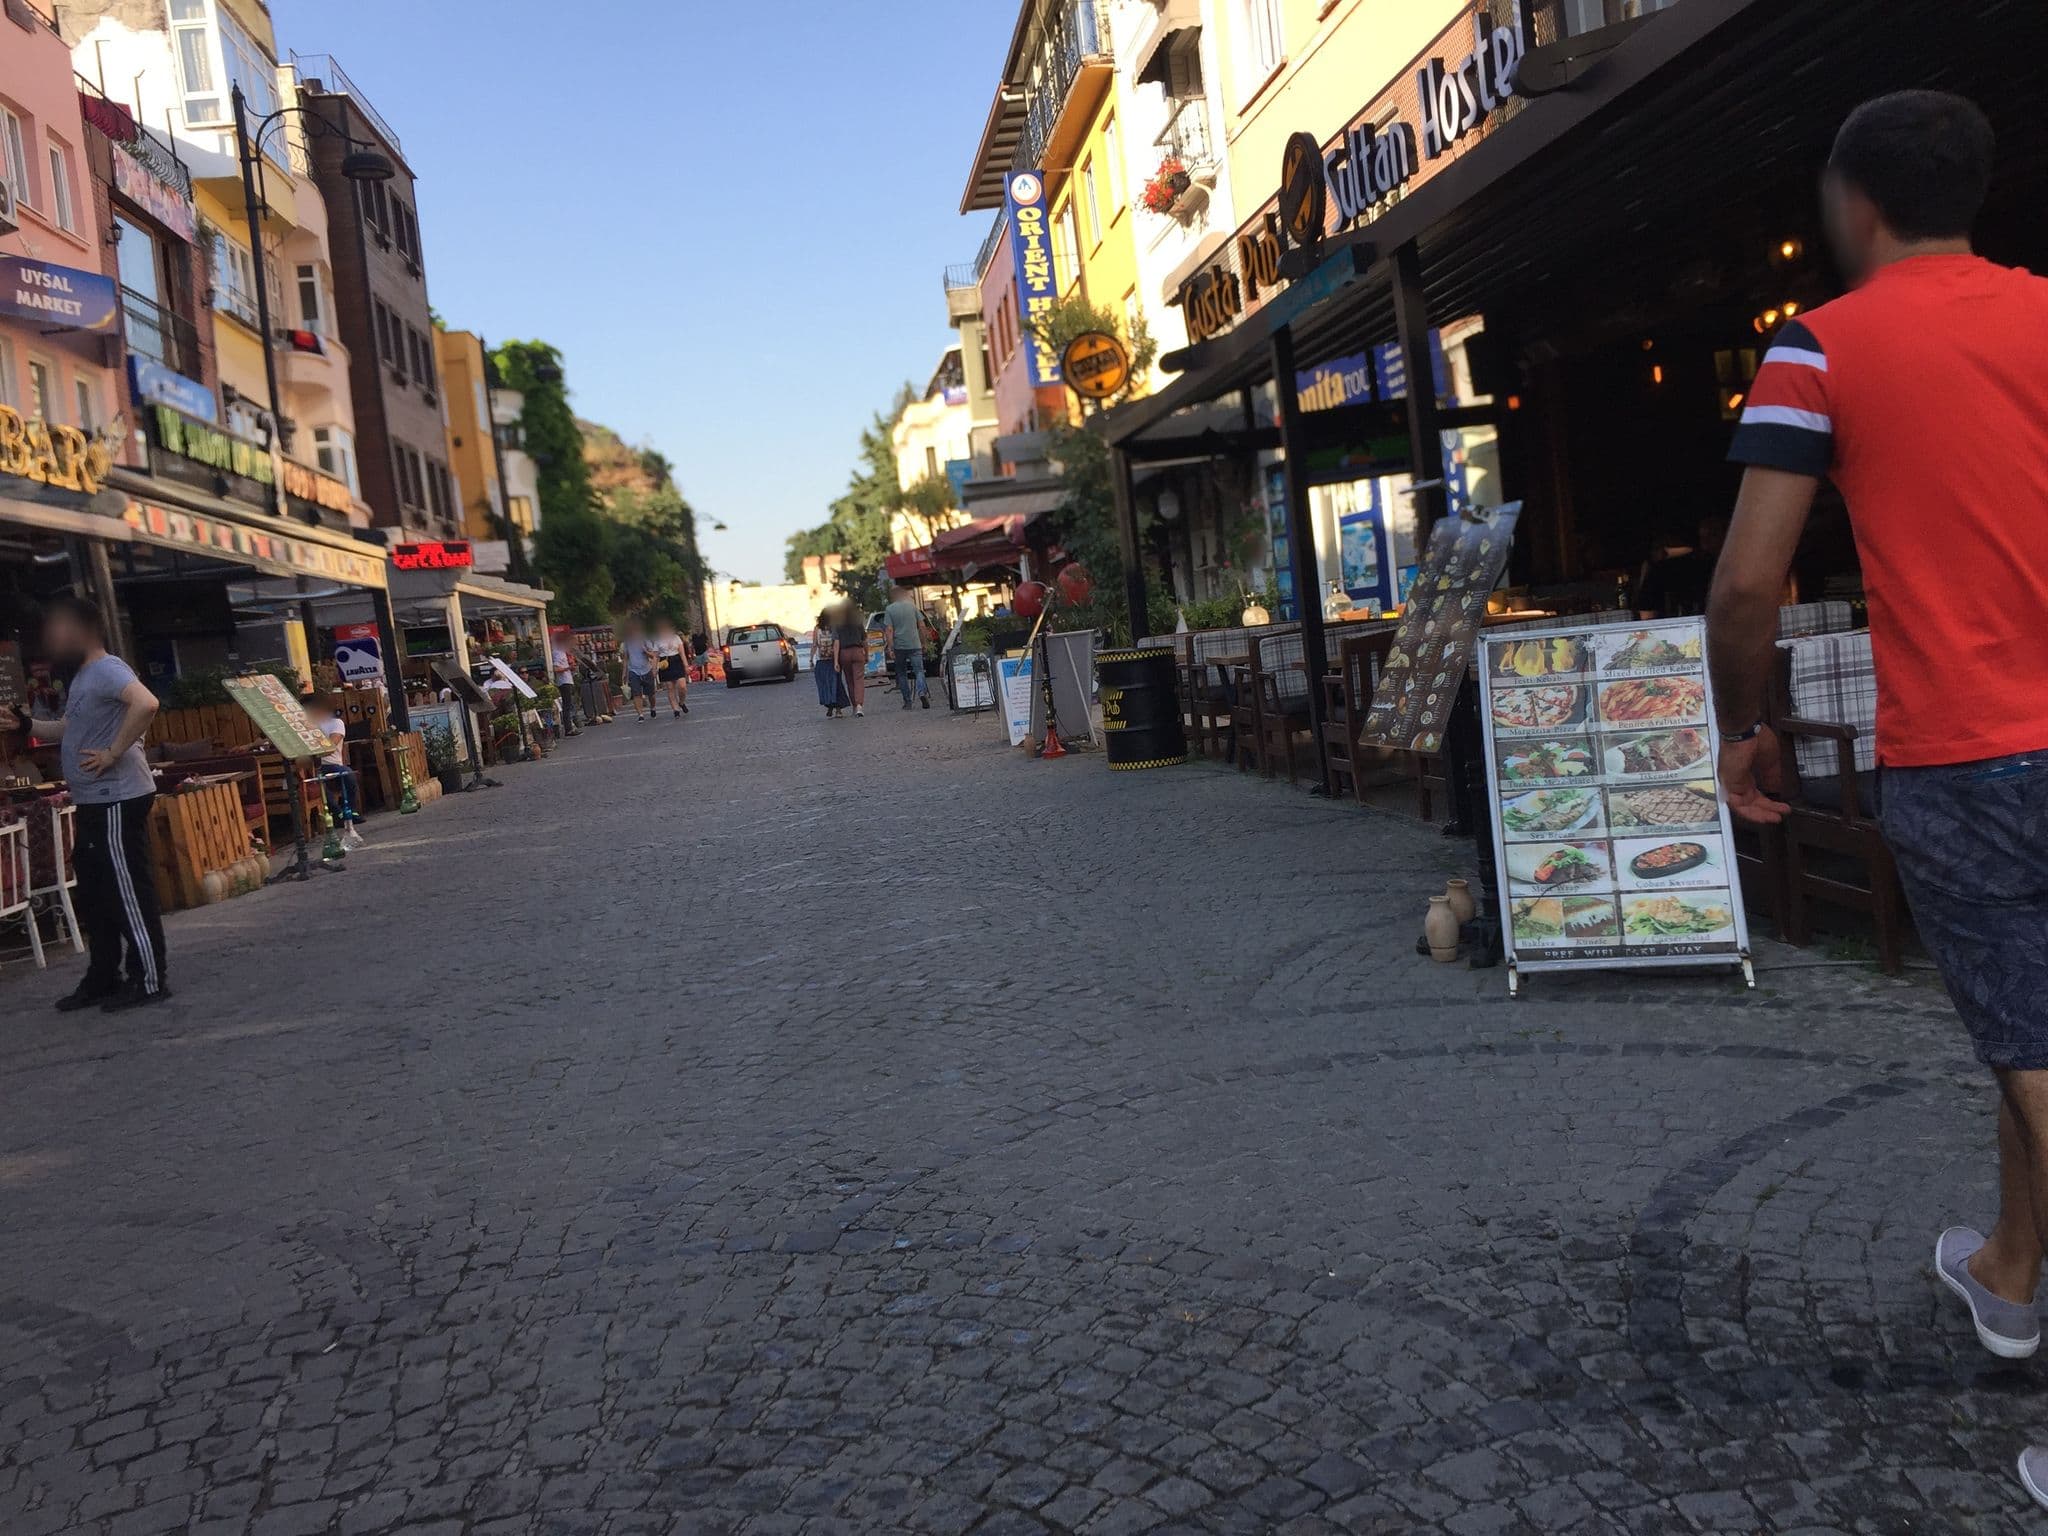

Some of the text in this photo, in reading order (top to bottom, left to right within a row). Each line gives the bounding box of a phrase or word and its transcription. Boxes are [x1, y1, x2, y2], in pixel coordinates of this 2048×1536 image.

[1323, 0, 1527, 232] Sultan Hostel
[1016, 207, 1051, 291] ORIENT
[20, 267, 73, 293] UYSAL
[1183, 266, 1237, 345] Gusta
[1237, 213, 1281, 301] Pub
[15, 289, 82, 316] MARKET
[346, 665, 378, 676] LAVAZZA
[1535, 675, 1563, 684] Kebab
[1604, 664, 1697, 678] Mixed Grilled Kebab
[1618, 720, 1643, 729] Penne
[1529, 832, 1545, 840] Sea
